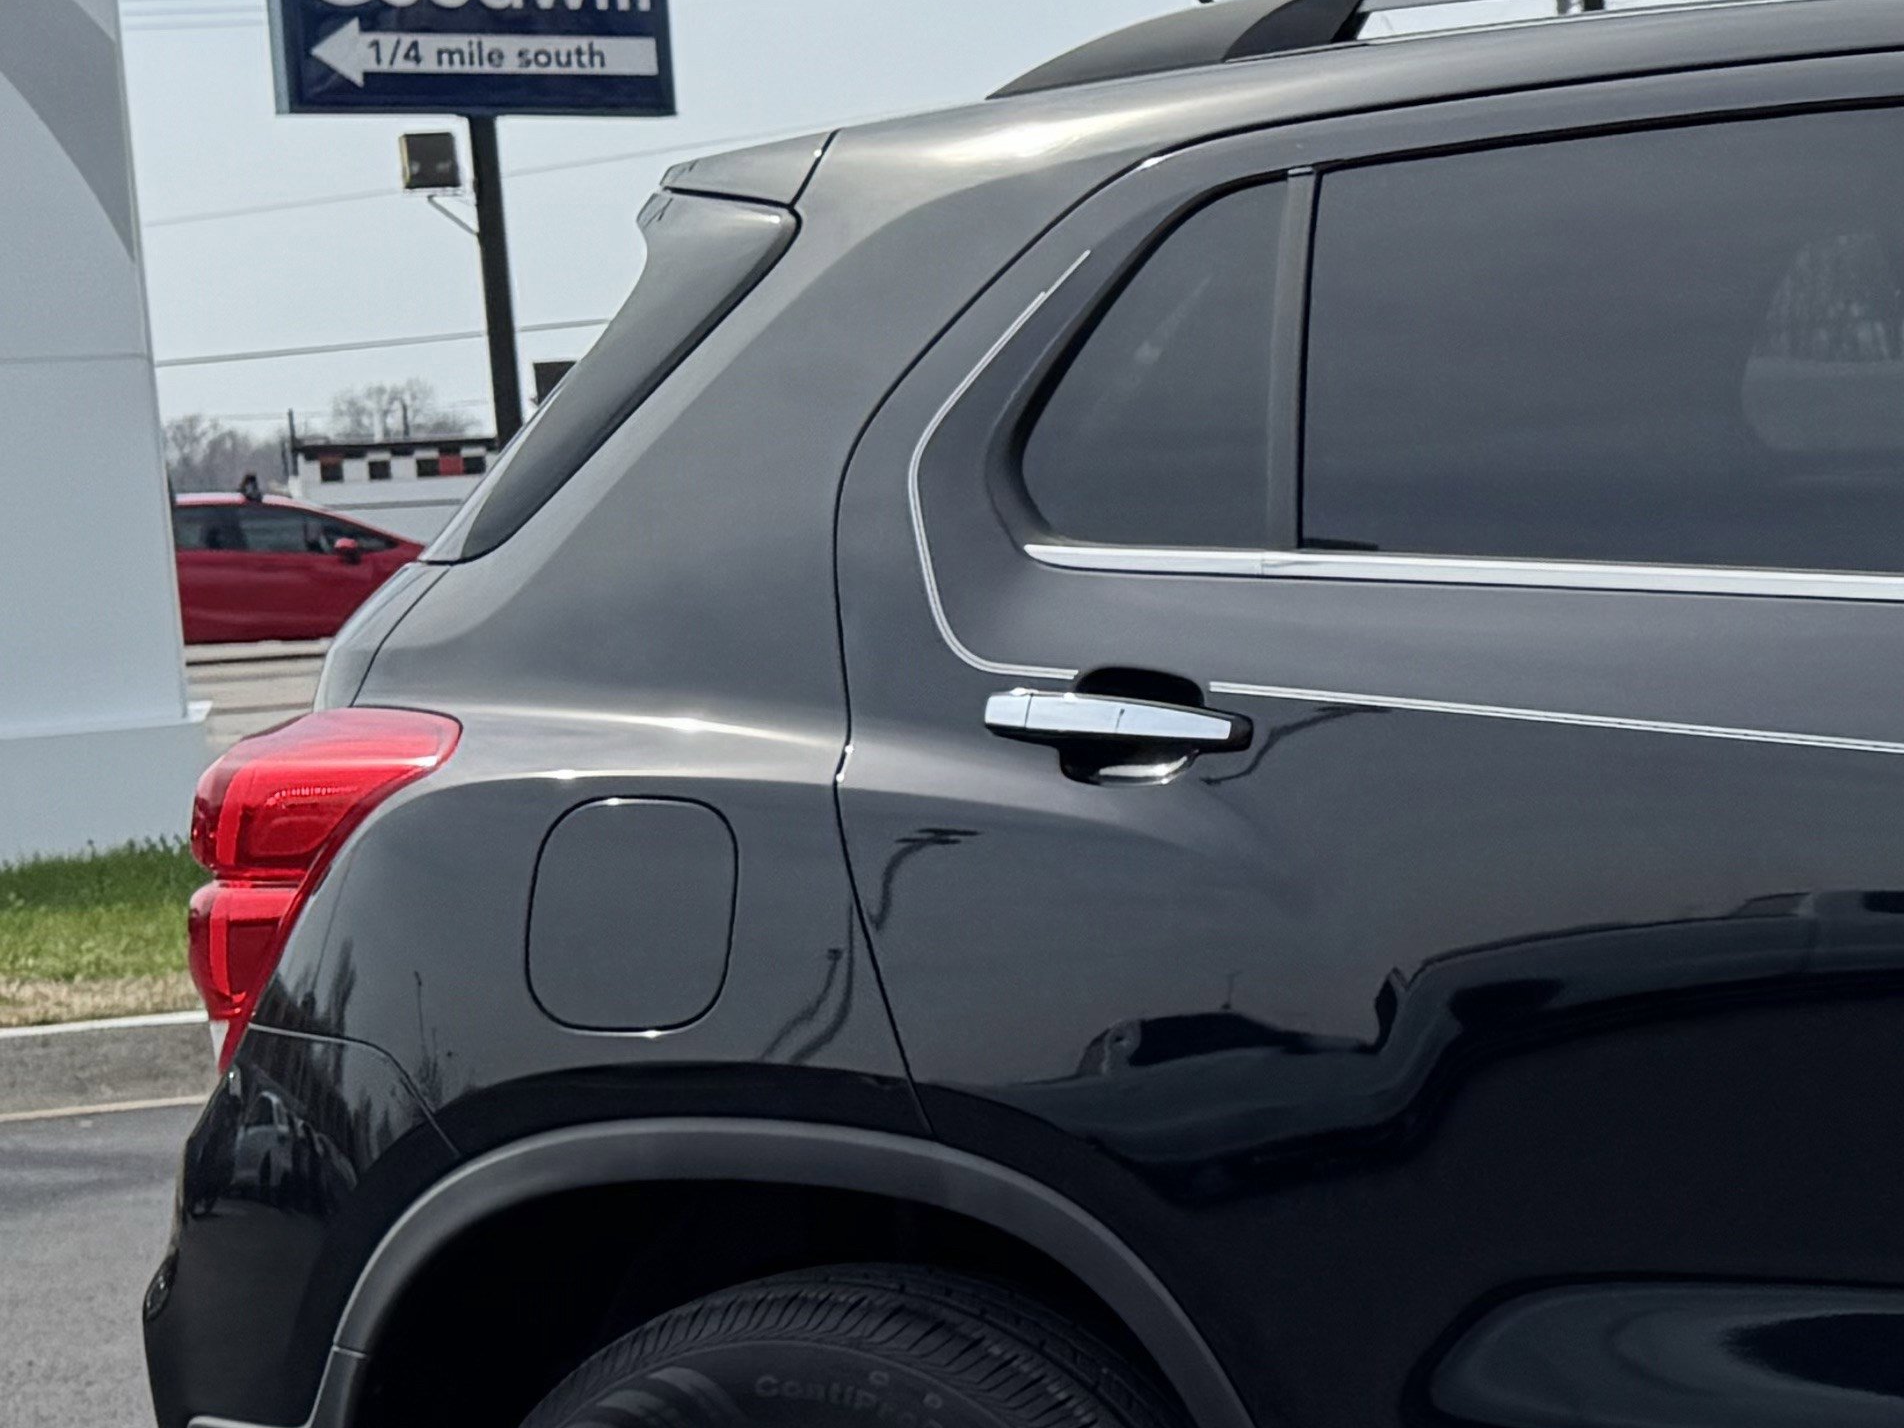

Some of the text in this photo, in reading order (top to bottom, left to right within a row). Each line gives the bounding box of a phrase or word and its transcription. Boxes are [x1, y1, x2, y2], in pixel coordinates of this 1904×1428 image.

[367, 40, 607, 69] 1/4 mile south
